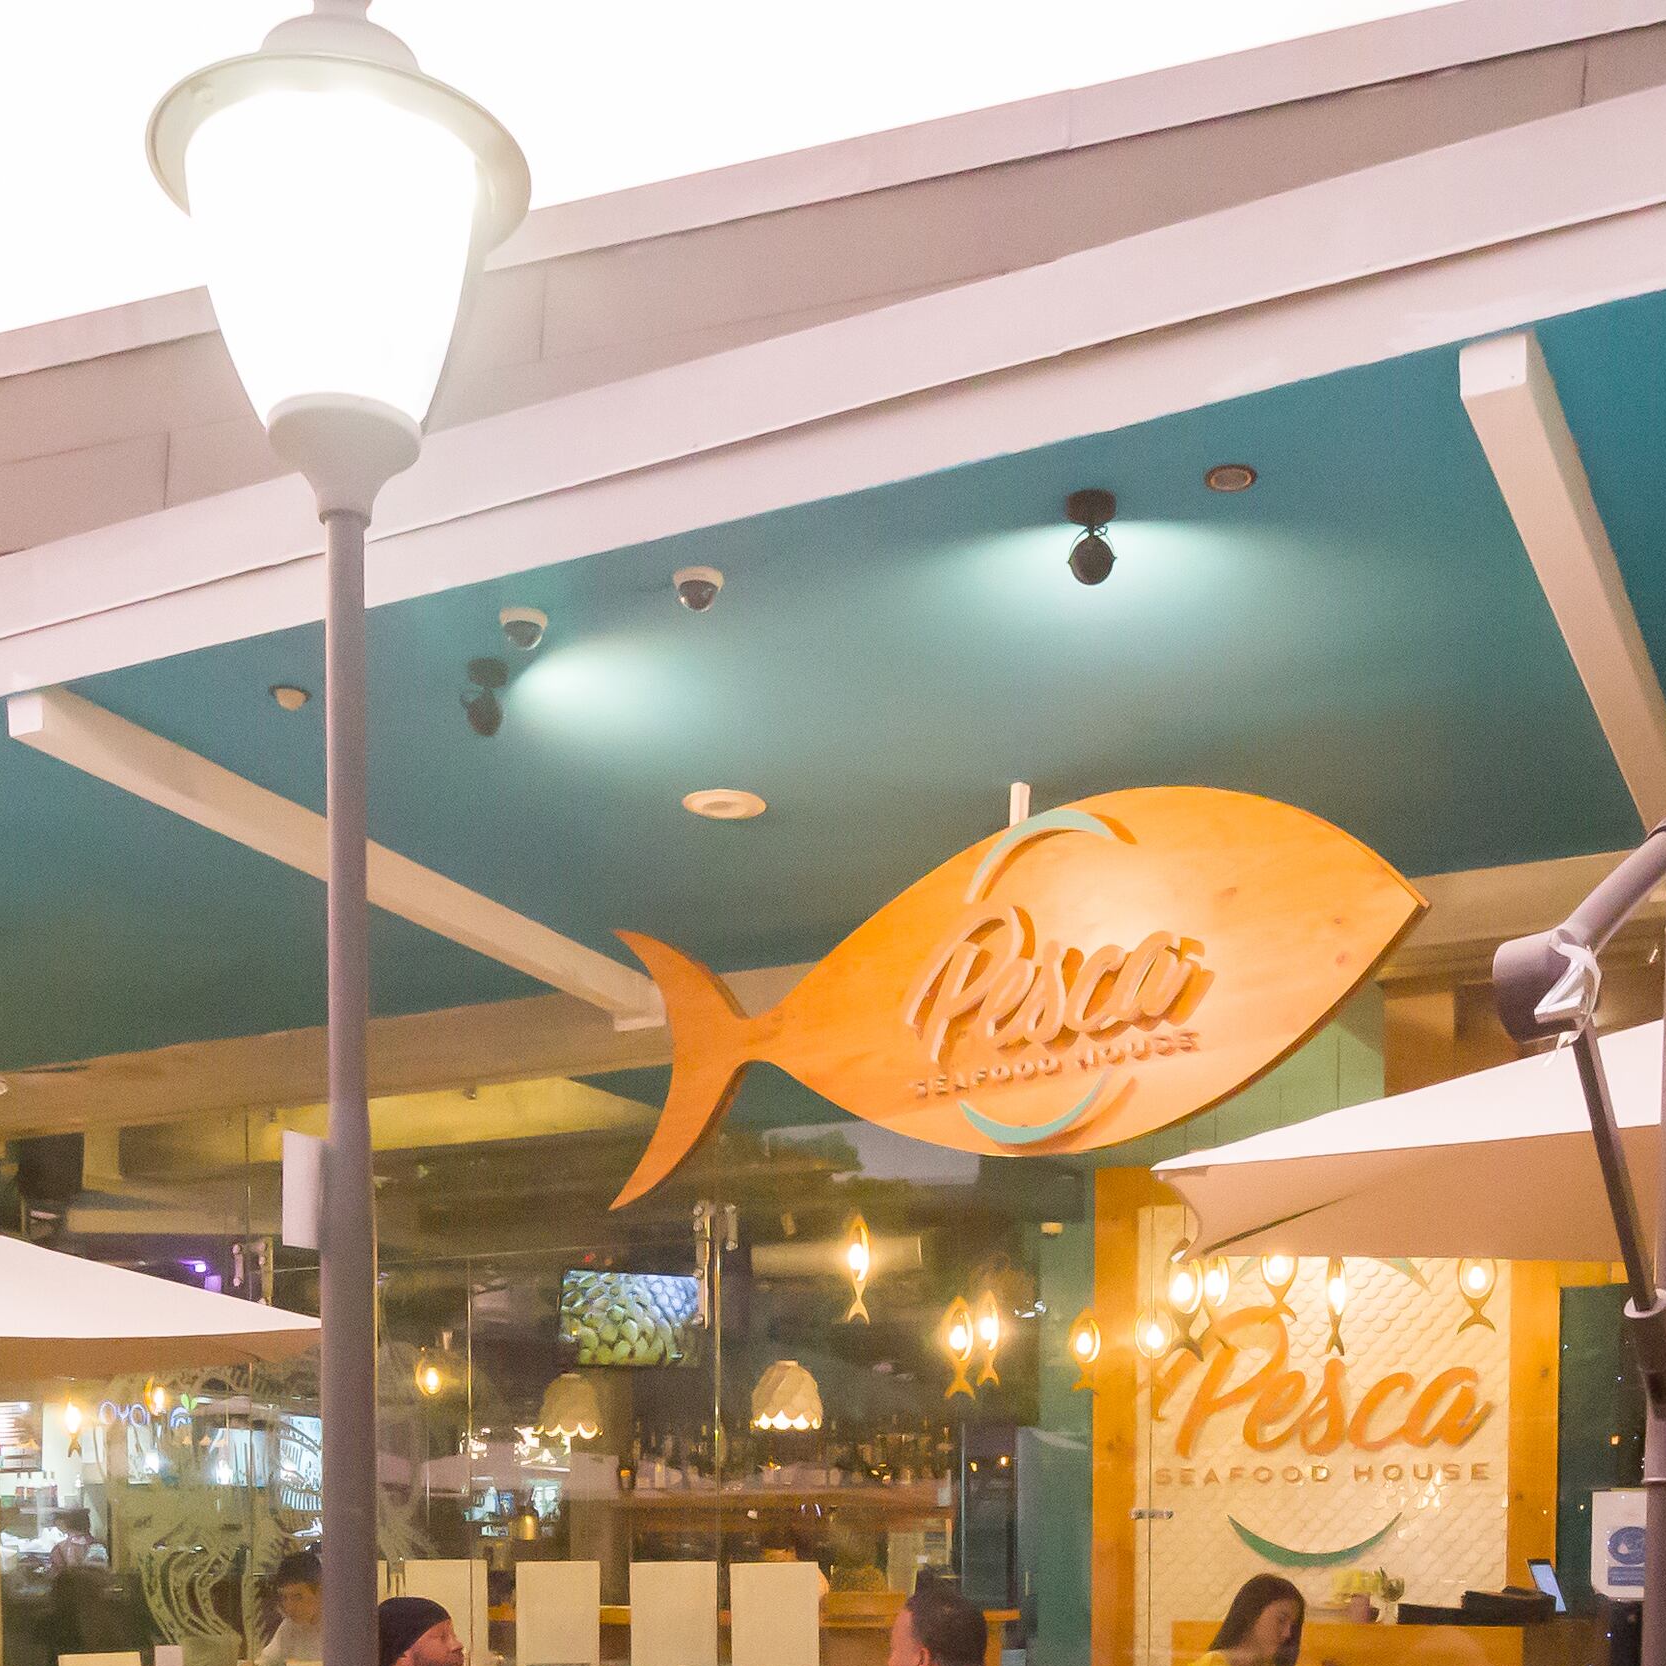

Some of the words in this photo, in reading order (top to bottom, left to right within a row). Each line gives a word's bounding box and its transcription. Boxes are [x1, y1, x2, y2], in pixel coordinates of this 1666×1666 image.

[905, 905, 1213, 1064] Pesca
[911, 1056, 1062, 1099] SEAFOOD
[1077, 1030, 1209, 1070] HOUSE
[1153, 1305, 1496, 1459] Pesca
[1154, 1463, 1333, 1487] SEAFOOD
[1353, 1462, 1492, 1482] HOUSE
